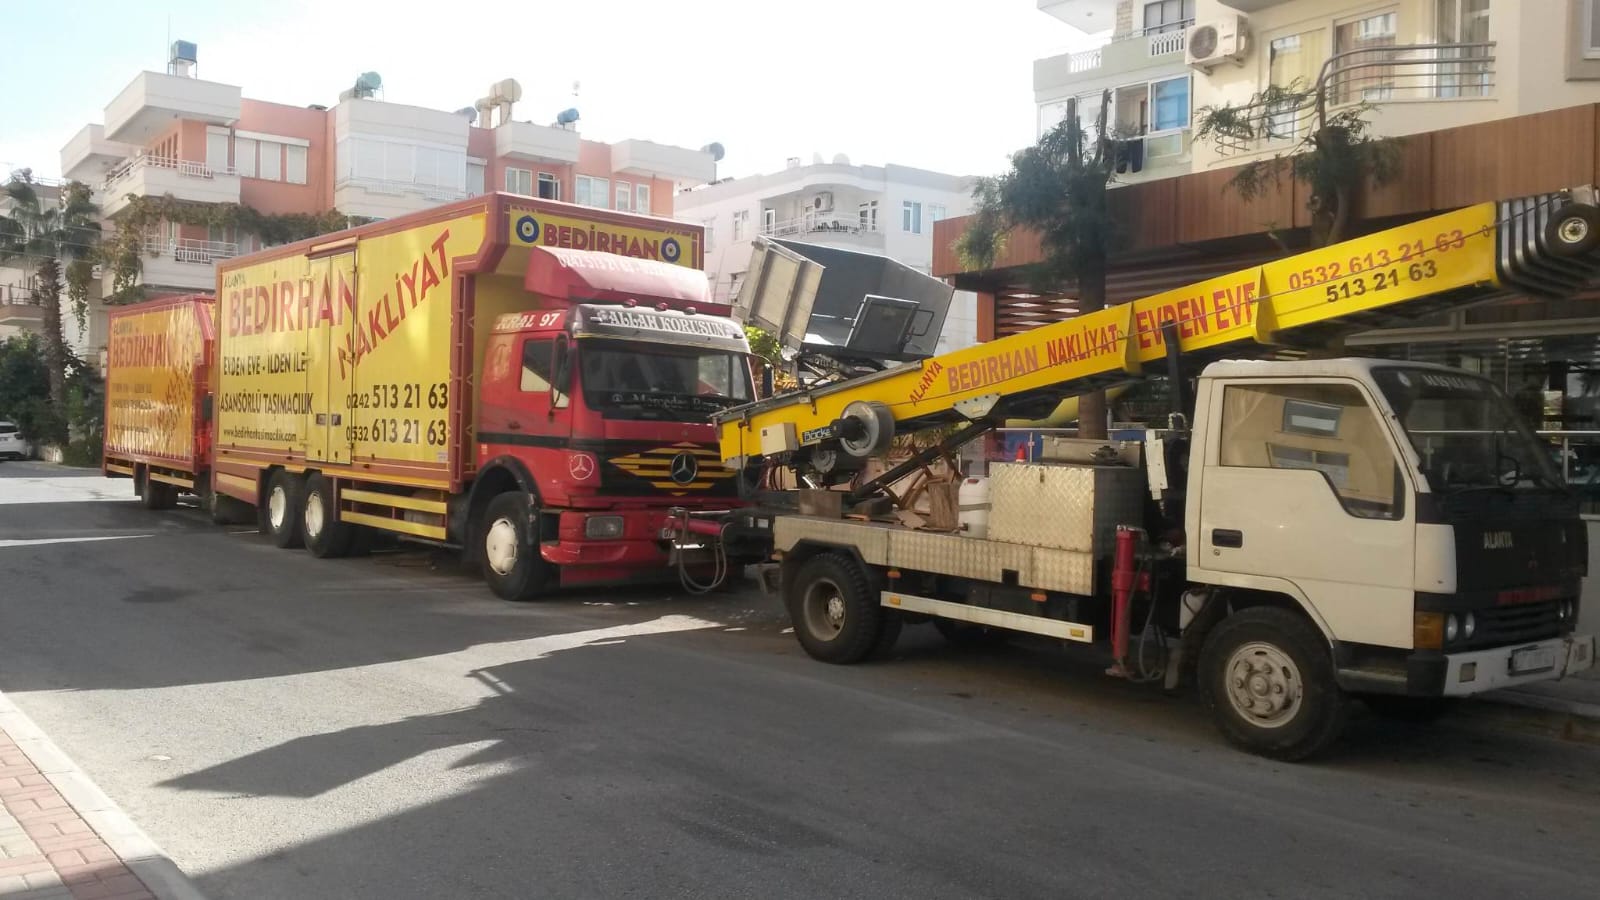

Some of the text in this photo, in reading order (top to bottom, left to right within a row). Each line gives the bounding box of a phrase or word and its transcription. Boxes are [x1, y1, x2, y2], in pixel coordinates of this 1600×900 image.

[543, 223, 659, 260] BEDİRHAN
[1289, 229, 1465, 290] 0532 613 21 63
[1326, 259, 1437, 303] 513 21 63
[229, 269, 354, 337] BEDİRHAN
[337, 228, 450, 380] NAKLİYAT
[496, 312, 560, 331] KRAL 97
[1136, 295, 1208, 349] EVDEN
[609, 311, 727, 337] ALLAH KORUSUN
[224, 356, 246, 376] EVDEN
[247, 355, 260, 375] EVE
[909, 324, 1118, 407] ALANYA BEDİRHAN NAKLİYAT
[346, 382, 449, 409] 0242 513 21 63
[346, 418, 447, 446] 0532 613 21 63
